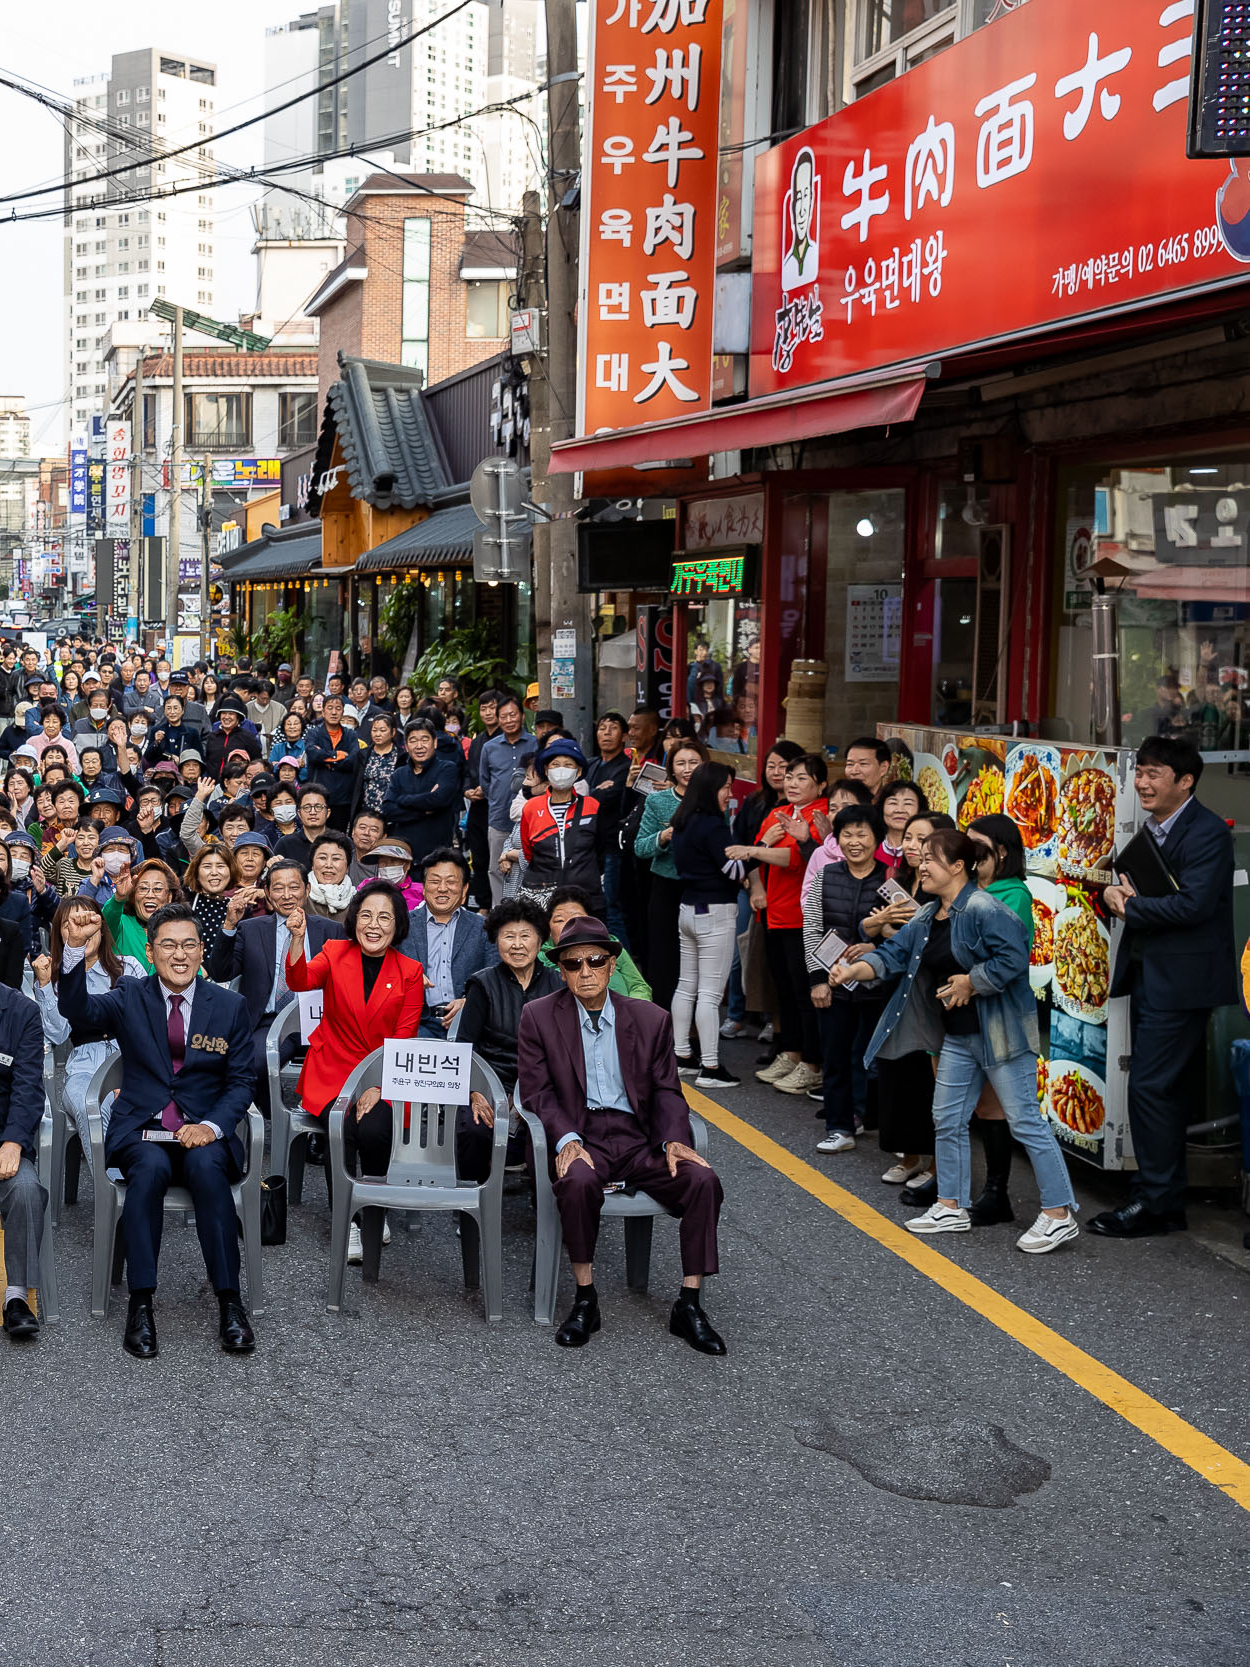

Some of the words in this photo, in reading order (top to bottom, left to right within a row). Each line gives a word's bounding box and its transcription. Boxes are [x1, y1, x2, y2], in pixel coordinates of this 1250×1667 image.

[594, 0, 641, 410] 가주우육면대
[633, 0, 707, 404] 加州牛肉面大
[840, 230, 948, 325] 우육면대왕
[1051, 246, 1133, 299] 가맹/예약문의
[1138, 244, 1153, 273] 02
[1157, 233, 1189, 268] 6465
[874, 589, 889, 601] 10
[190, 1033, 229, 1055] 오신환
[395, 1051, 460, 1076] 내빈석
[447, 1081, 461, 1090] 의장
